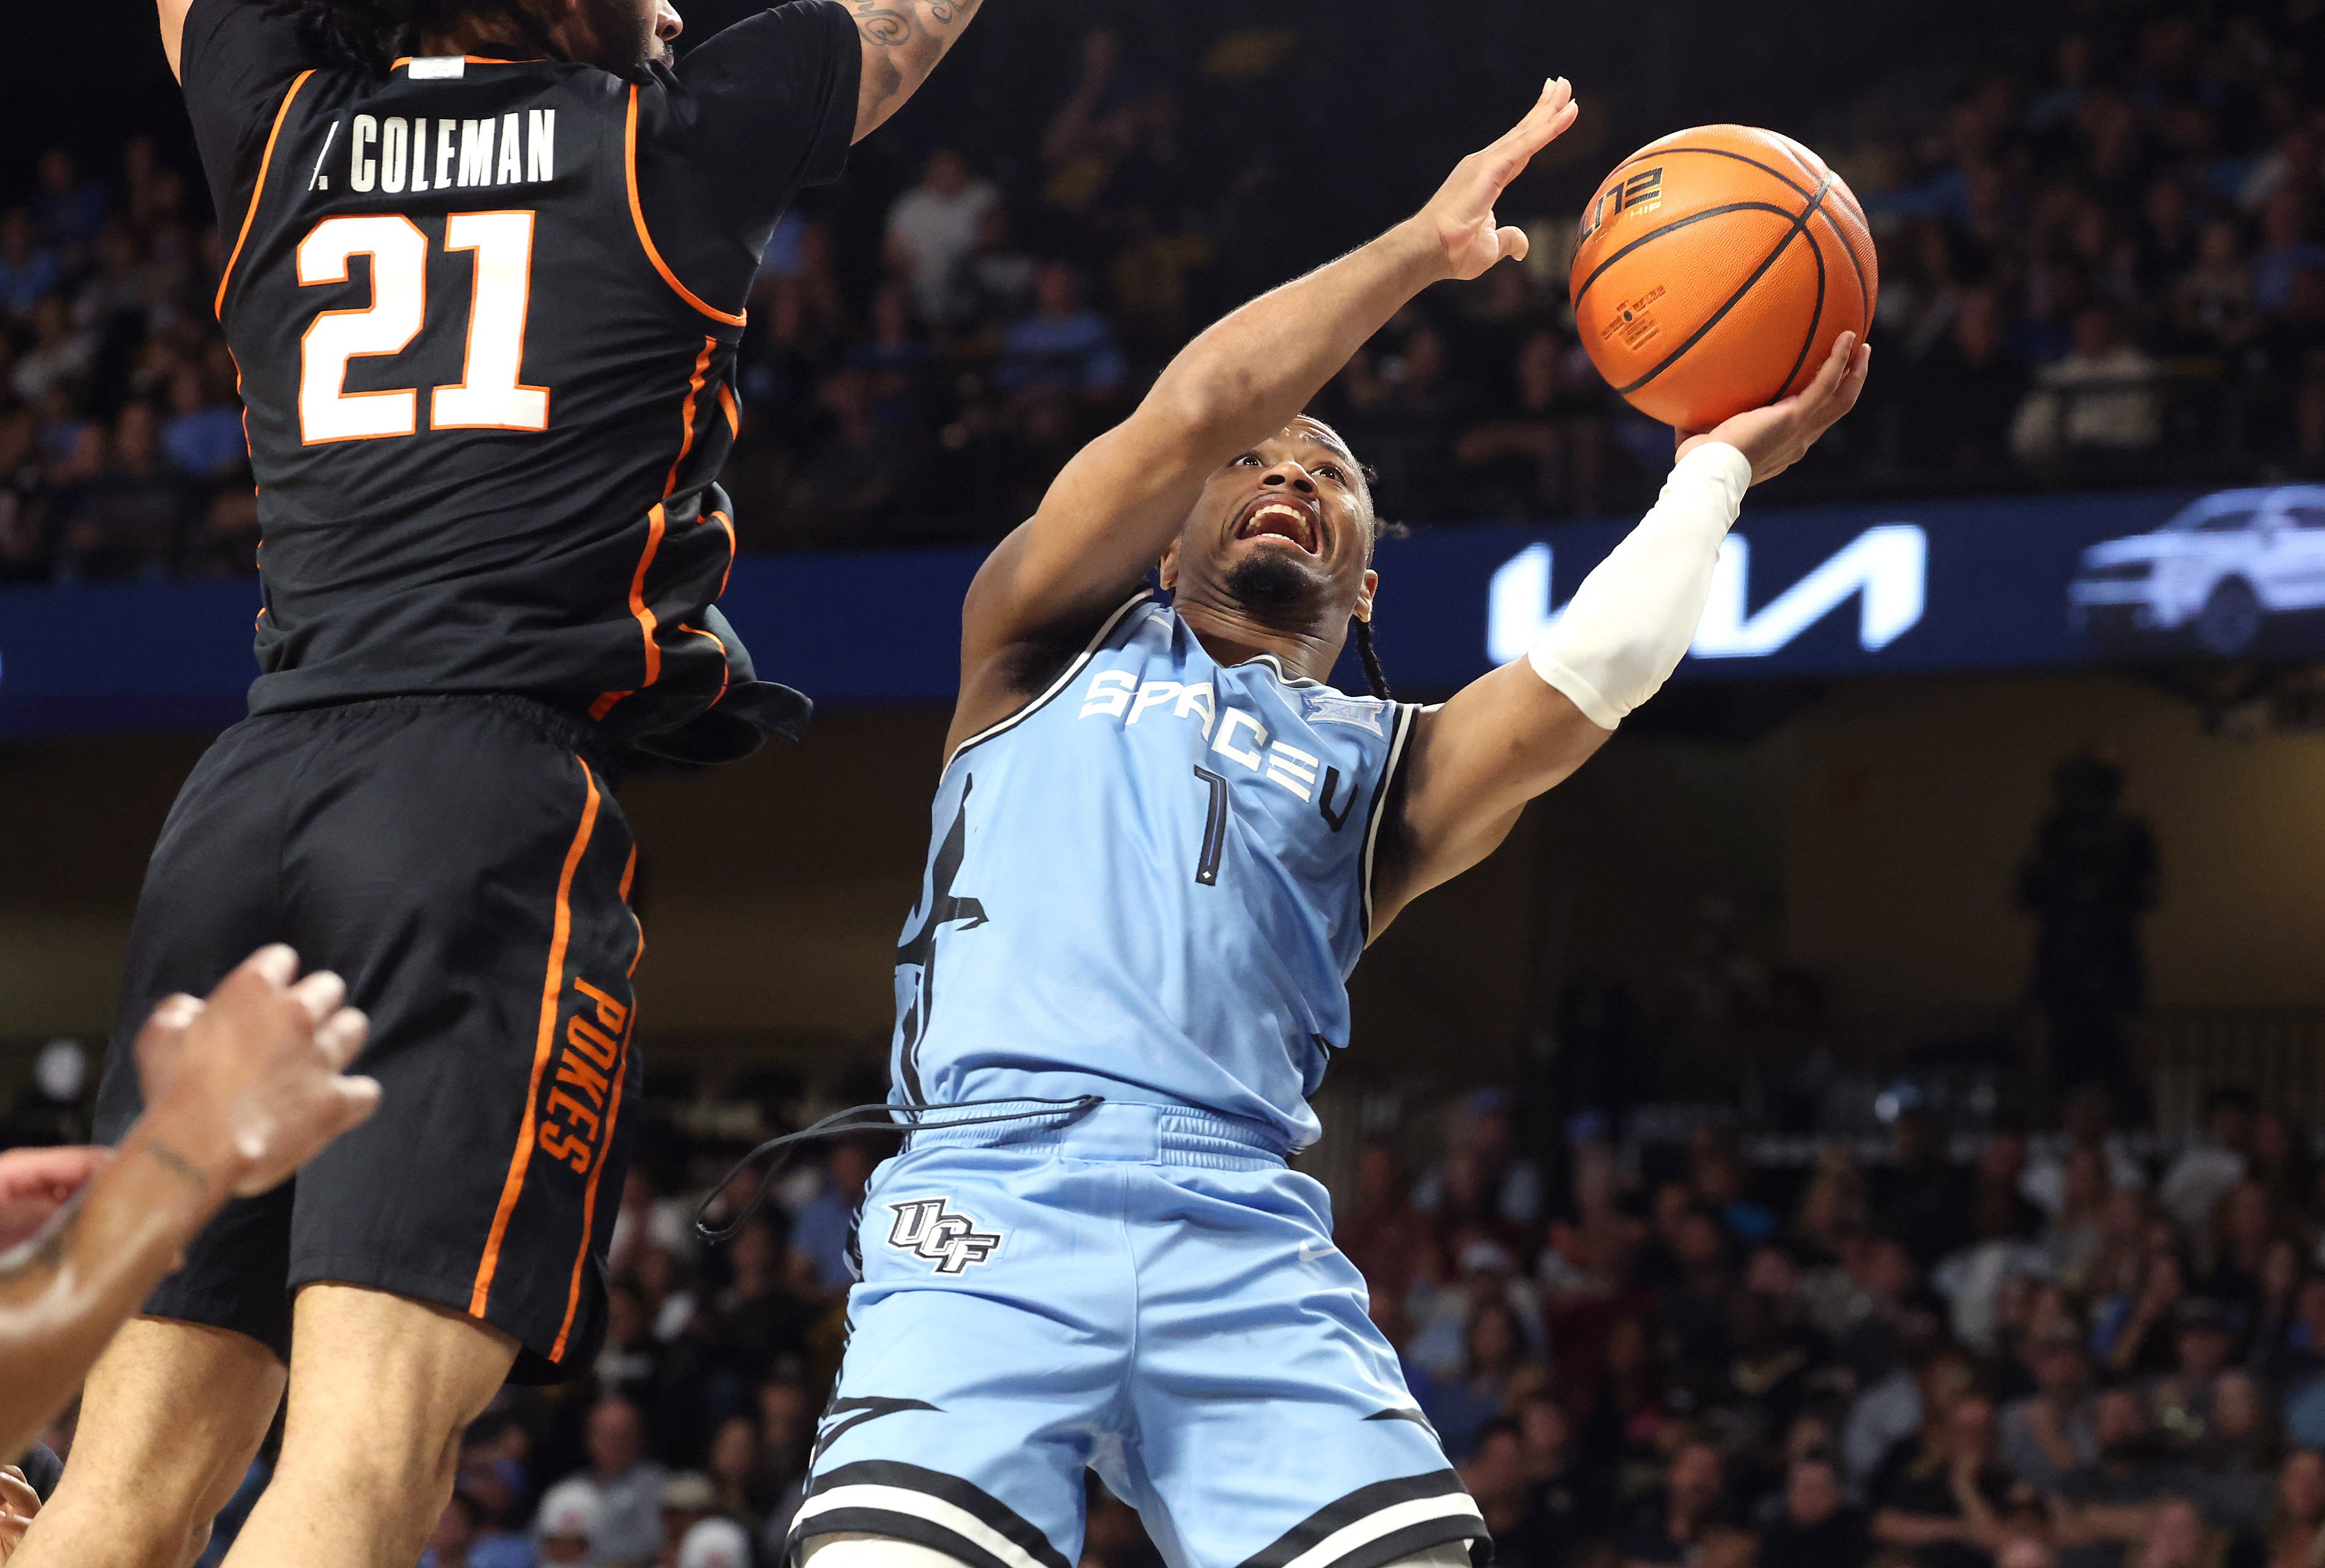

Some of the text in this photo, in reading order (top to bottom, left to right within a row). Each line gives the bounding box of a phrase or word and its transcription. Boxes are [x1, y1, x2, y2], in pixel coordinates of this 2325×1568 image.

[350, 109, 556, 193] COLEMAN
[296, 210, 550, 446] 21
[1194, 764, 1227, 886] 1
[538, 976, 628, 1175] POKES
[881, 1196, 1005, 1277] UCF
